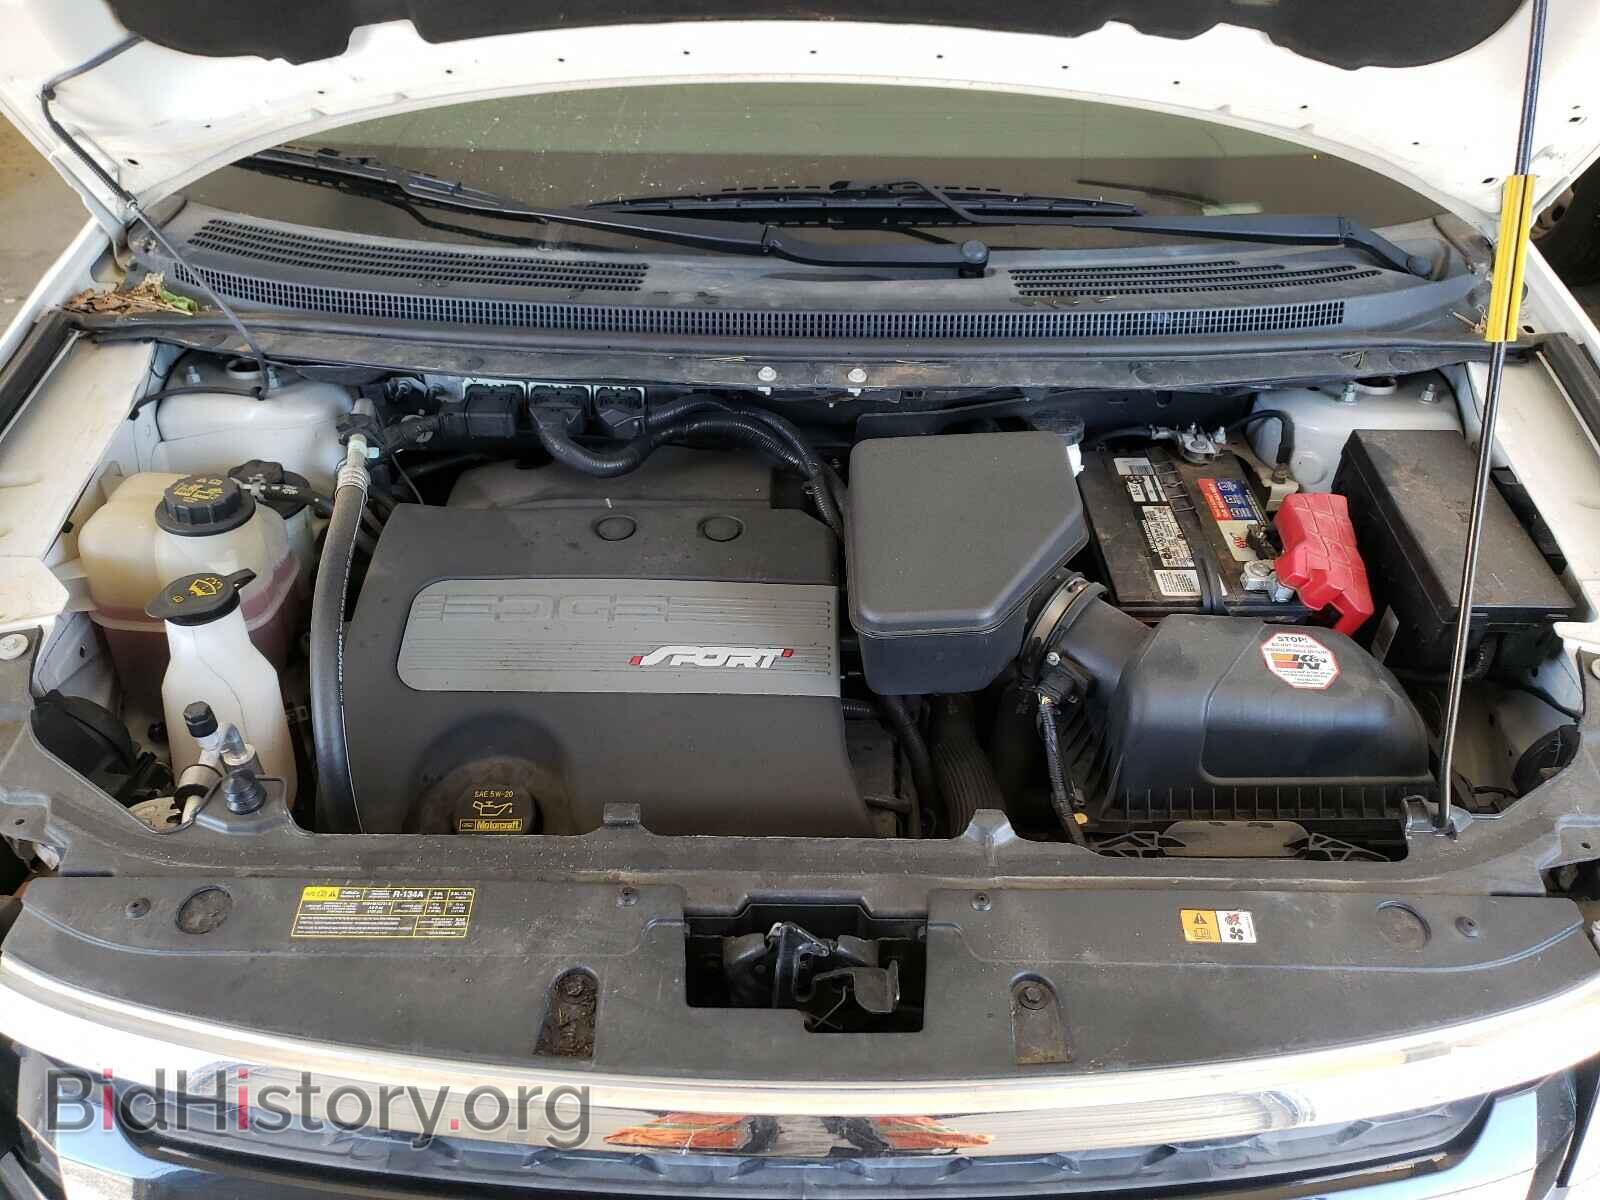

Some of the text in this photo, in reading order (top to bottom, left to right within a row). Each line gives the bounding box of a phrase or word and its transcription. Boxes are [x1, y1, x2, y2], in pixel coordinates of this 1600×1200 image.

[638, 645, 785, 670] SPORT
[474, 790, 514, 798] SAE 5W-20
[476, 820, 520, 829] Motorcraft
[392, 889, 424, 898] R-134A
